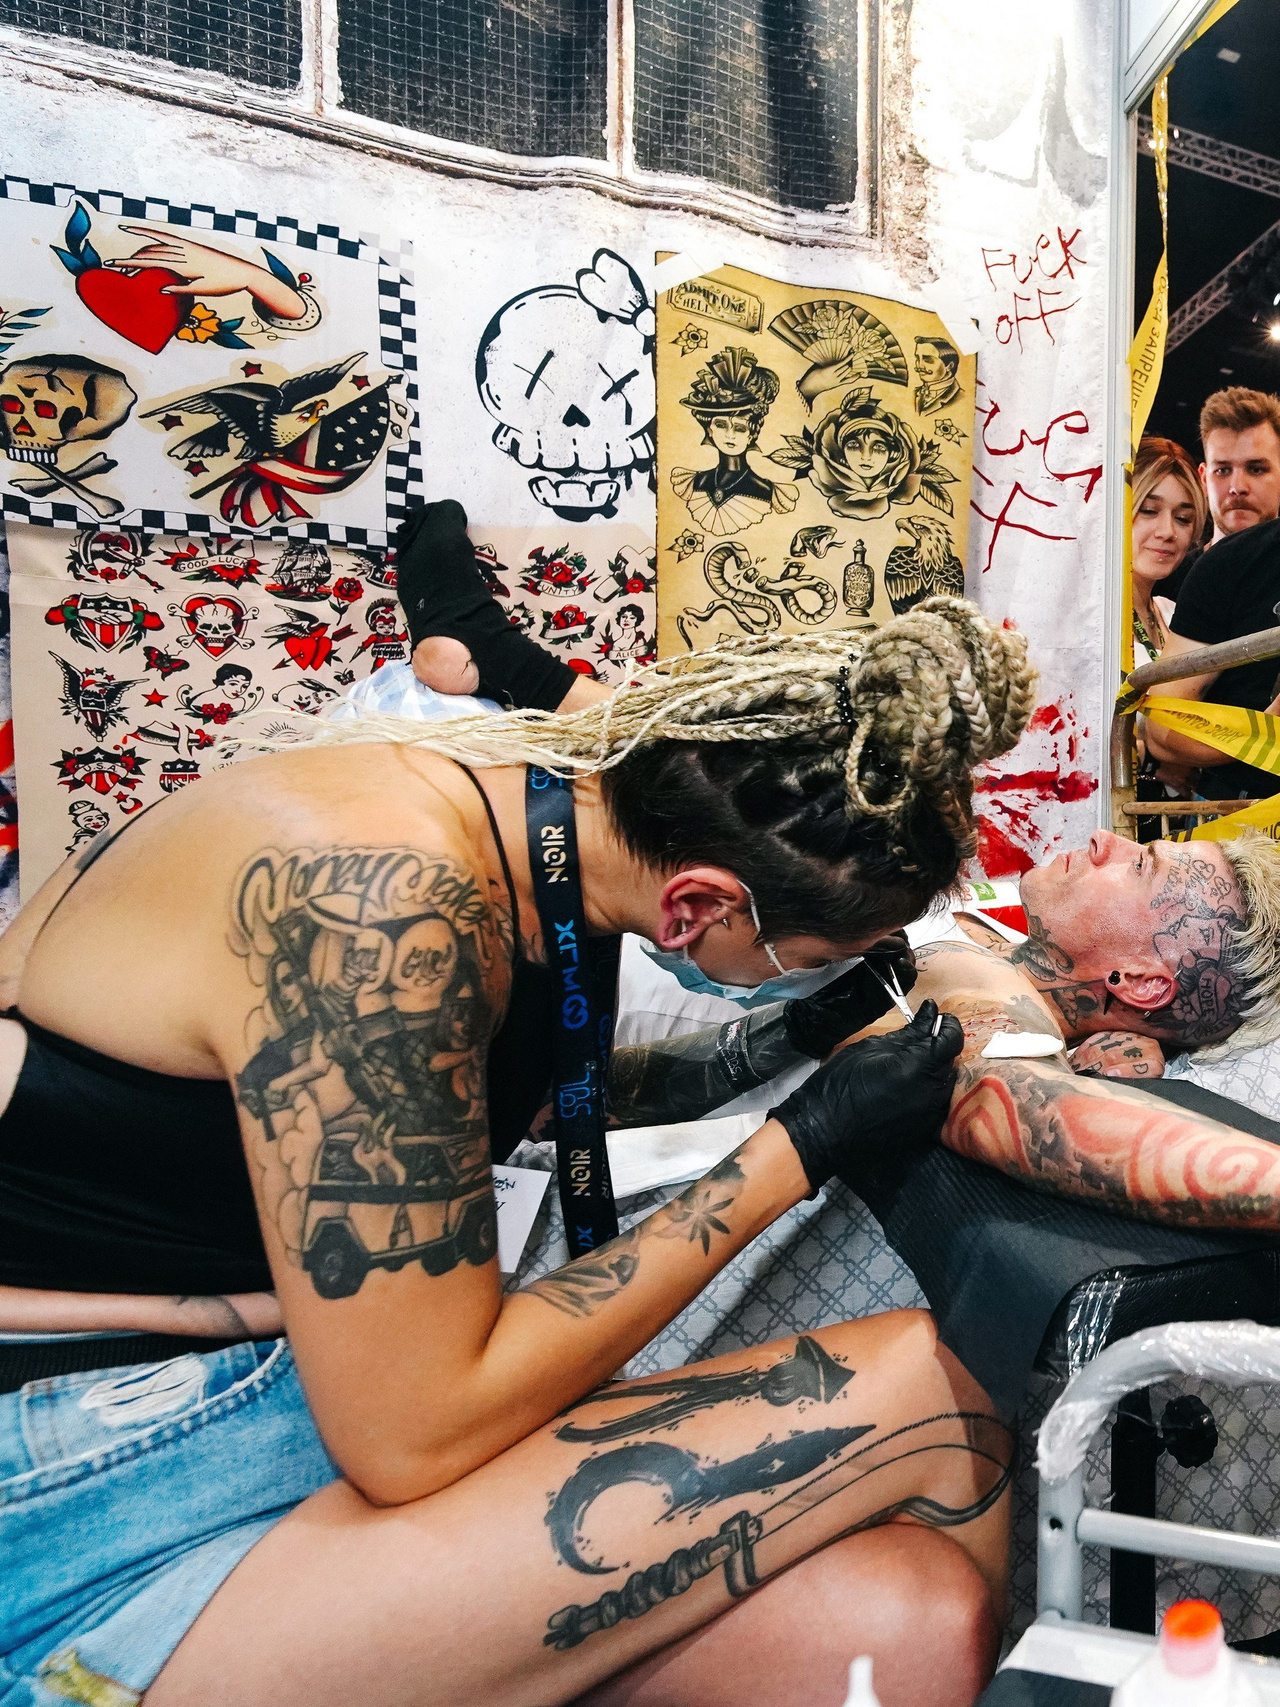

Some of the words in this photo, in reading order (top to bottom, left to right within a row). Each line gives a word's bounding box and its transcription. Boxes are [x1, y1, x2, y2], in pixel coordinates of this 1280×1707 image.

[682, 298, 713, 315] HELL
[540, 584, 579, 596] UNITY
[615, 650, 641, 659] ALICE
[540, 825, 569, 884] NOIR
[1201, 976, 1216, 1017] HOPE
[569, 1148, 592, 1197] NOIR
